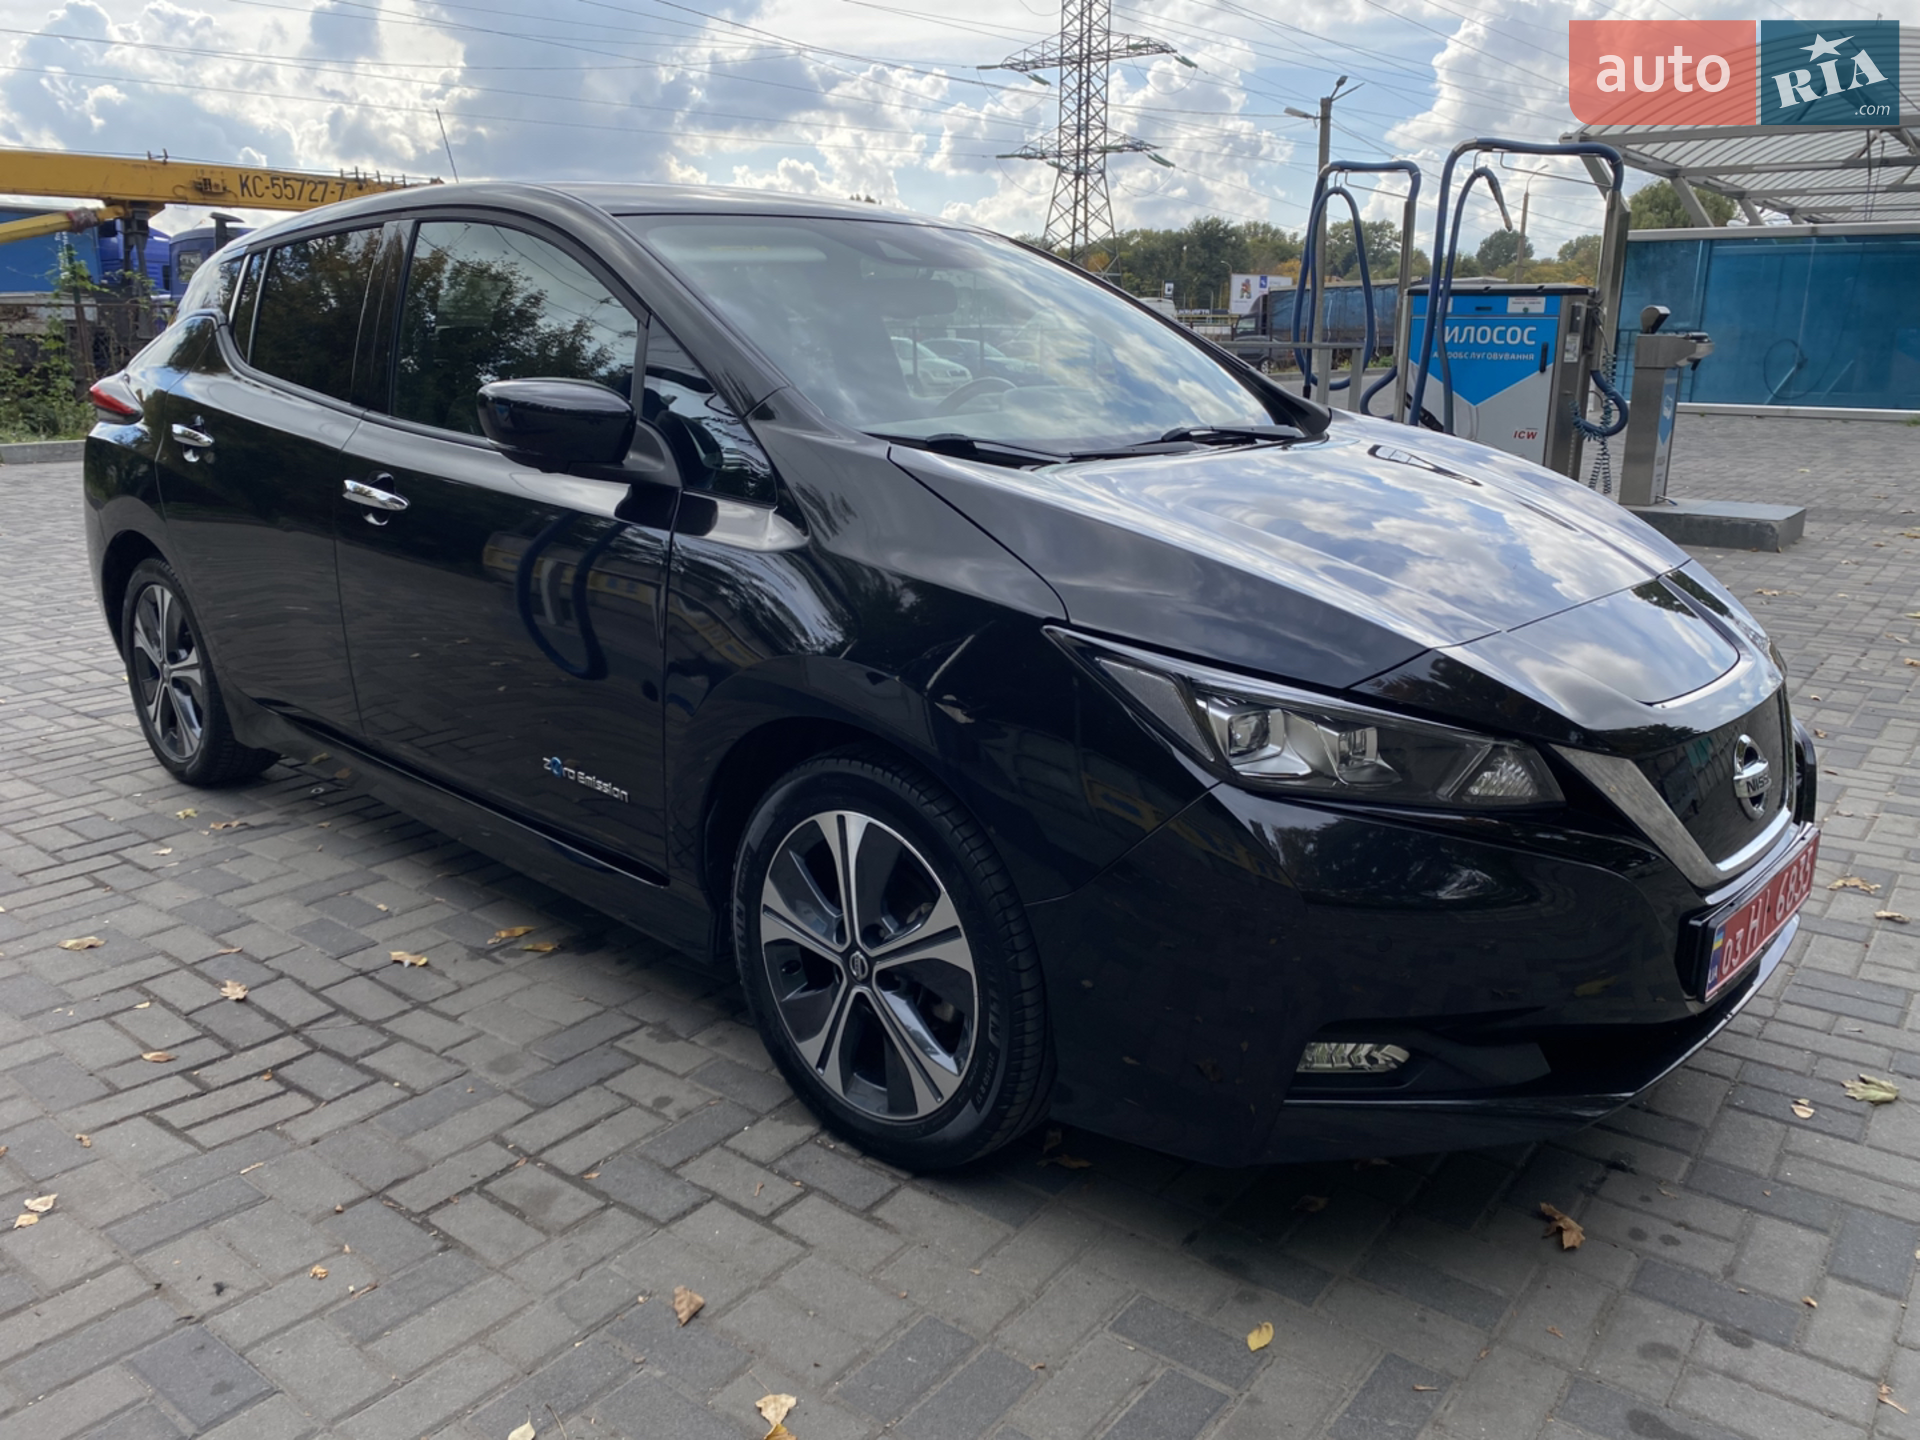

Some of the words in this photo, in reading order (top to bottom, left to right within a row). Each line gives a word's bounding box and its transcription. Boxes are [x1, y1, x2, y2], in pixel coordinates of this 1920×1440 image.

[1434, 325, 1537, 345] ИЛОСОС
[1513, 430, 1539, 440] ICW
[576, 771, 629, 803] Emission
[1722, 927, 1745, 976] 03
